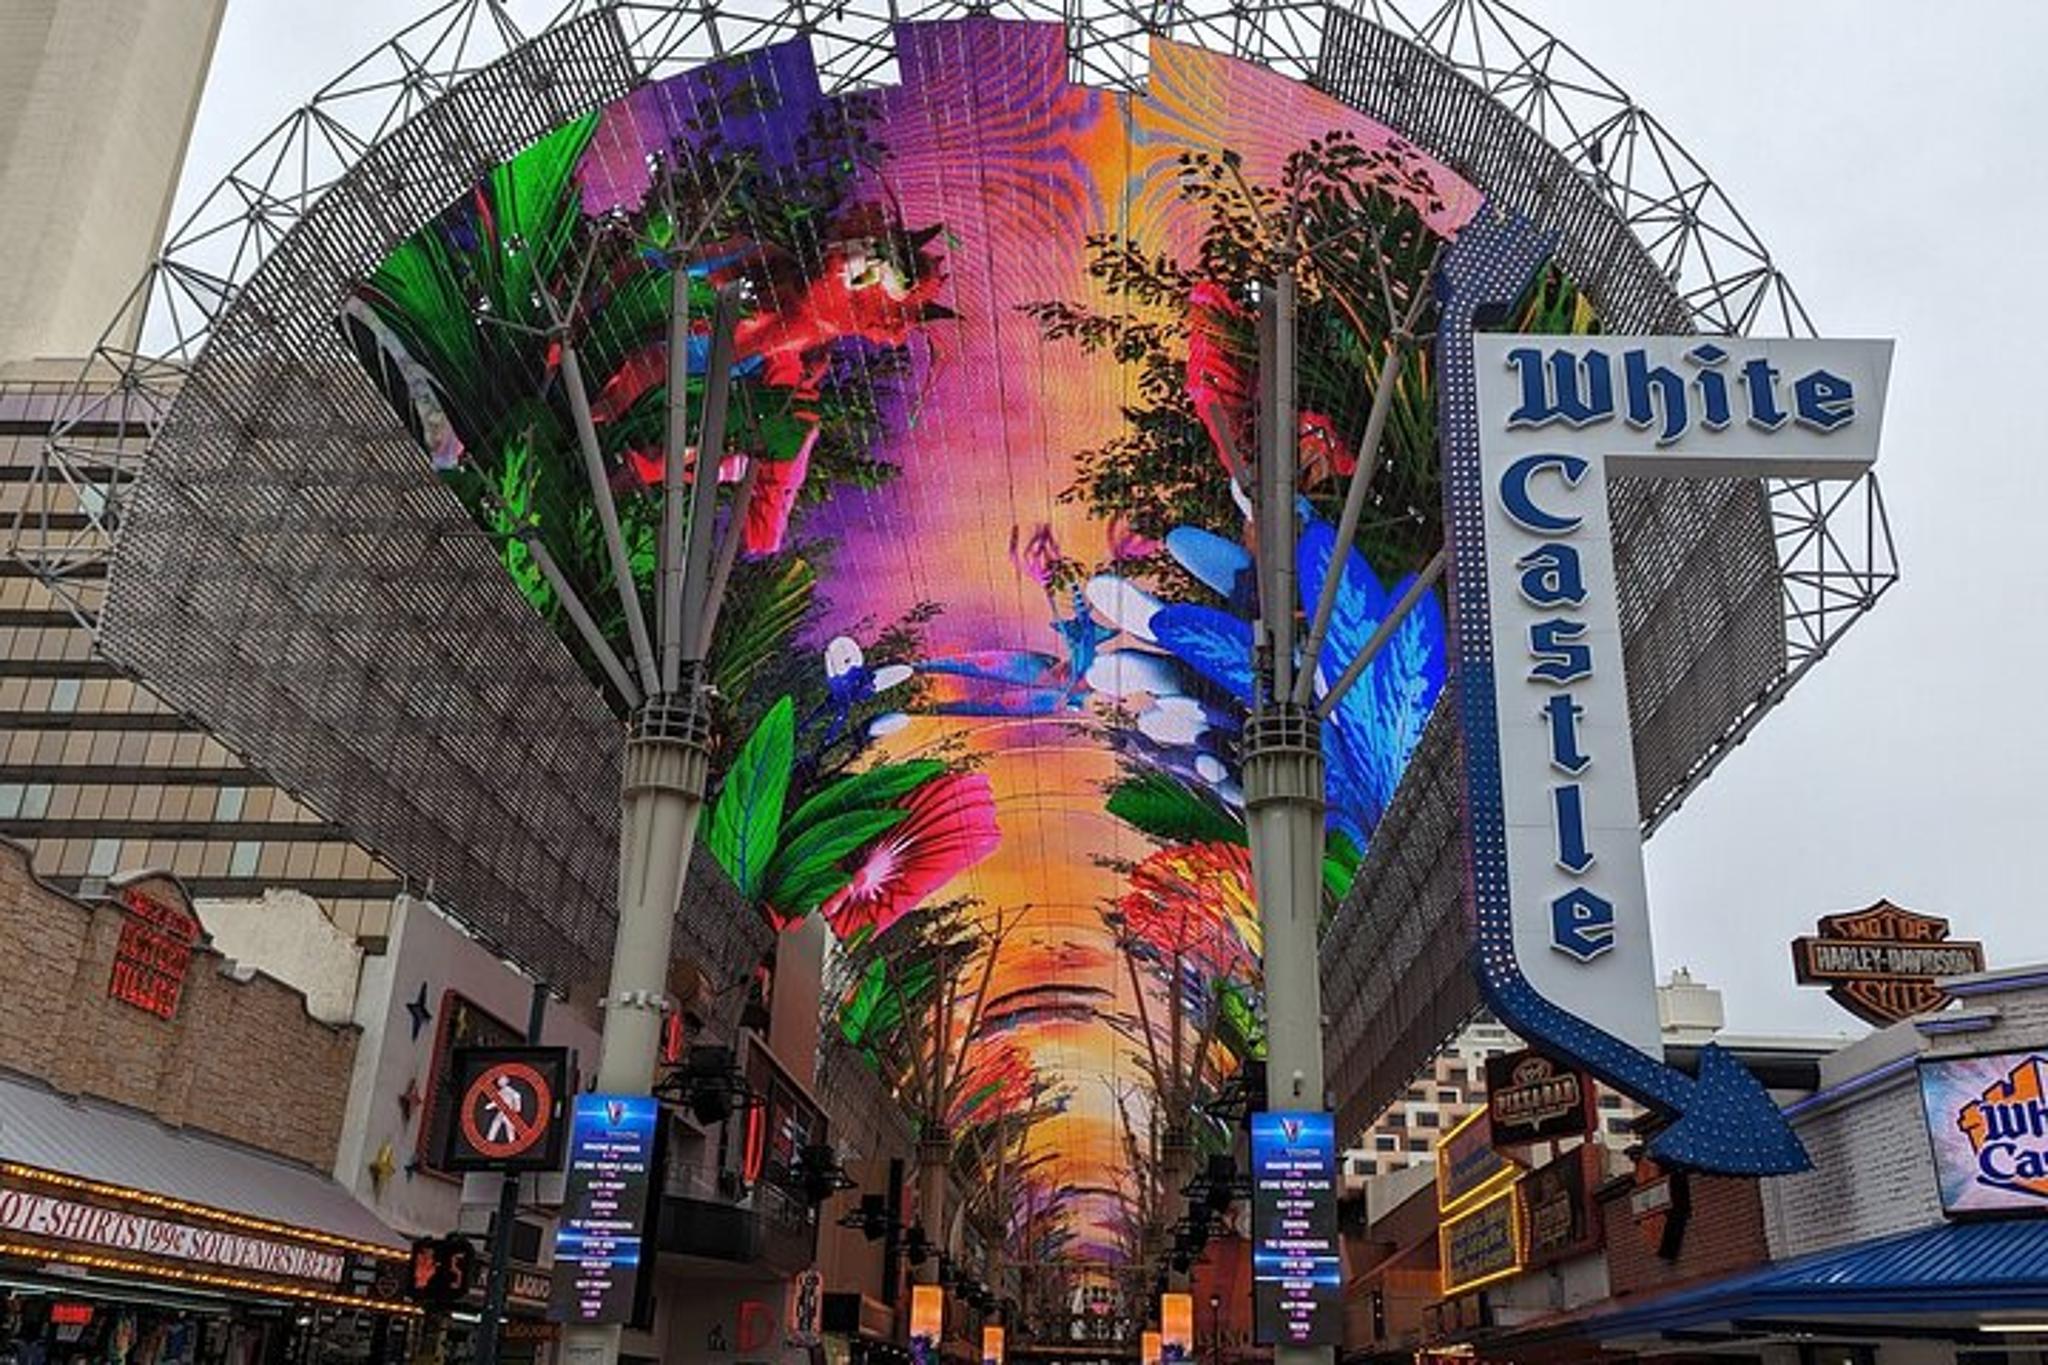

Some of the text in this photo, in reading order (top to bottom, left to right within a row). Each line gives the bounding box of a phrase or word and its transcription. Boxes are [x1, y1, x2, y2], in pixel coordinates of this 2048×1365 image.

[1506, 343, 1855, 447] White
[1500, 453, 1616, 963] Castle
[1850, 911, 1934, 940] MOTOR
[1815, 946, 1976, 976] HARLEY-DAVIDSON
